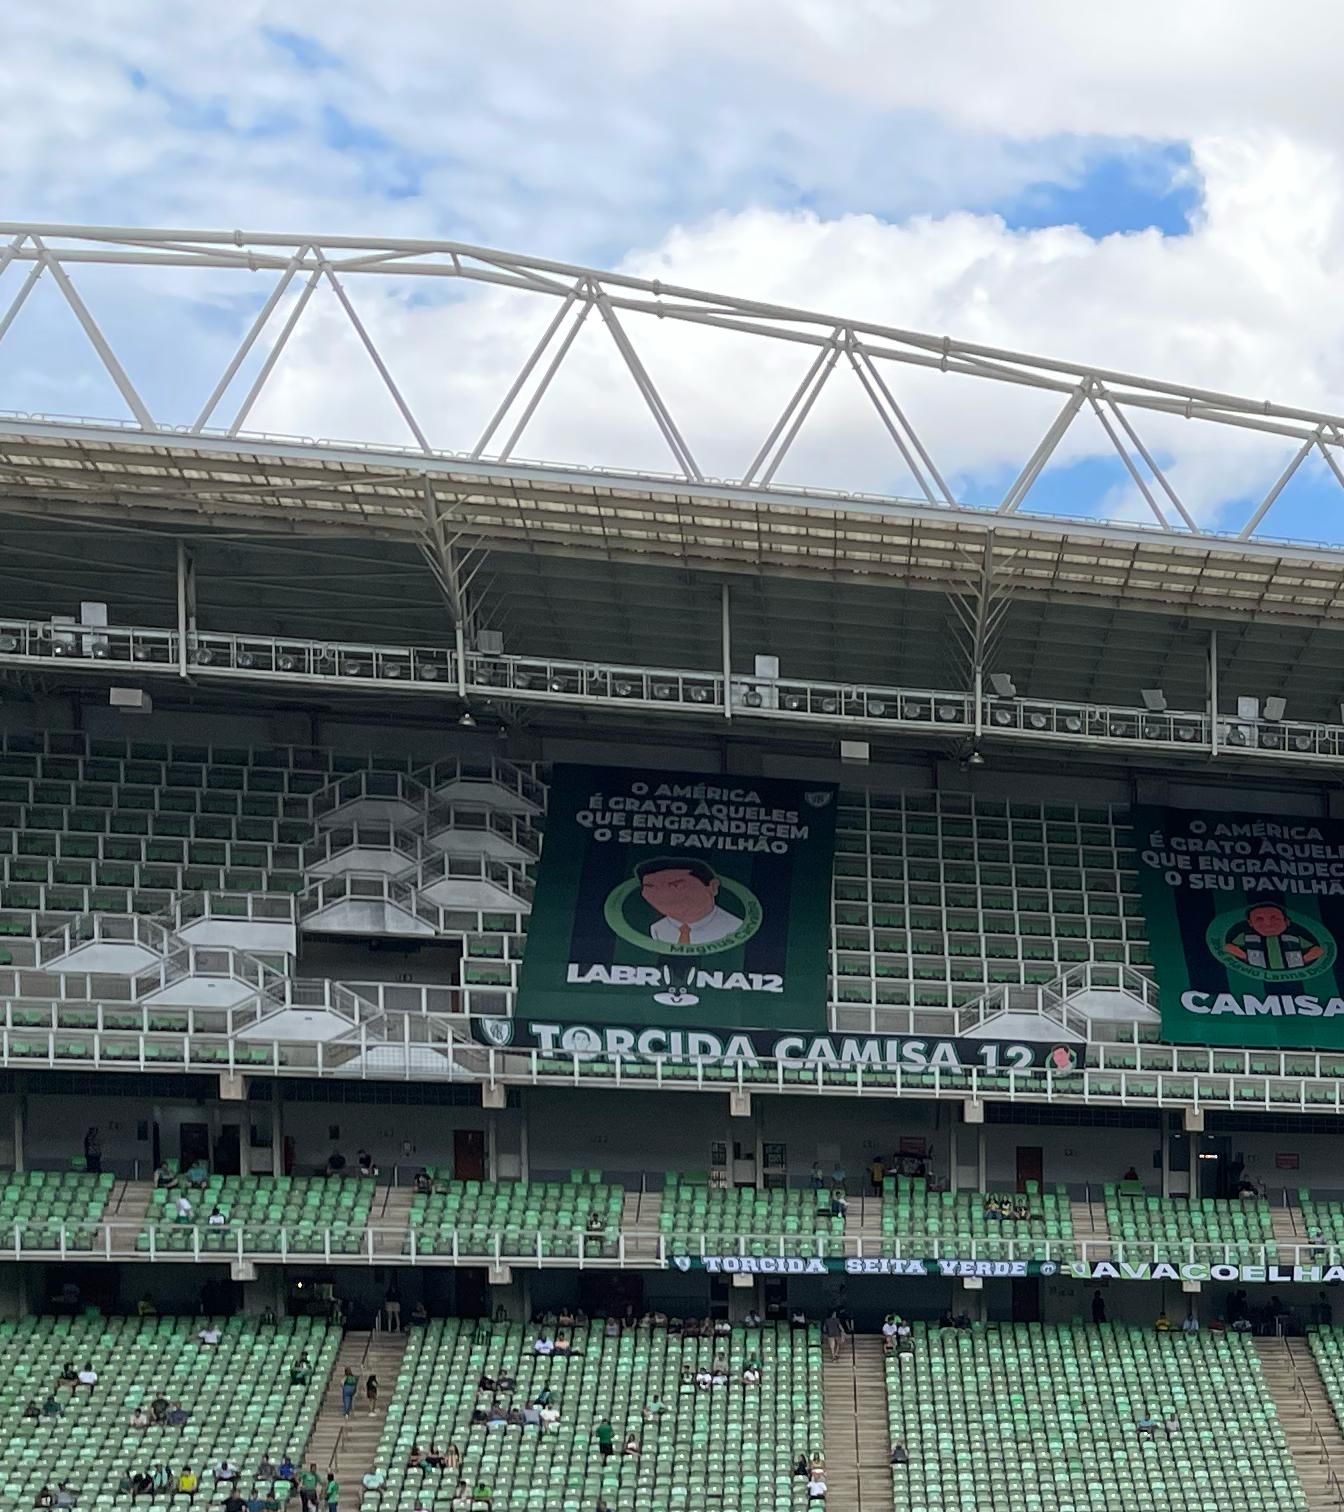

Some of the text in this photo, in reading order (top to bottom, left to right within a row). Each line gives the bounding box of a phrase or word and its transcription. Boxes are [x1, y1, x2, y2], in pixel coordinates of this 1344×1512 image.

[589, 793, 602, 809] É
[609, 796, 688, 815] GRATO
[631, 782, 760, 804] O AMÉRICA
[576, 809, 809, 840] QUE ENGRANDECEM
[1189, 820, 1323, 841] O AMÉRICA
[594, 828, 788, 855] O SEU PAVILHÃO
[1150, 831, 1165, 848] É
[1171, 837, 1252, 855] GRATO
[1141, 851, 1193, 870] QUE
[1165, 871, 1182, 886] O
[1189, 874, 1235, 891] SEU
[530, 1023, 1035, 1077] TORCIDA CAMISA 12
[703, 1256, 1028, 1277] TORCIDA SEITA VERDE
